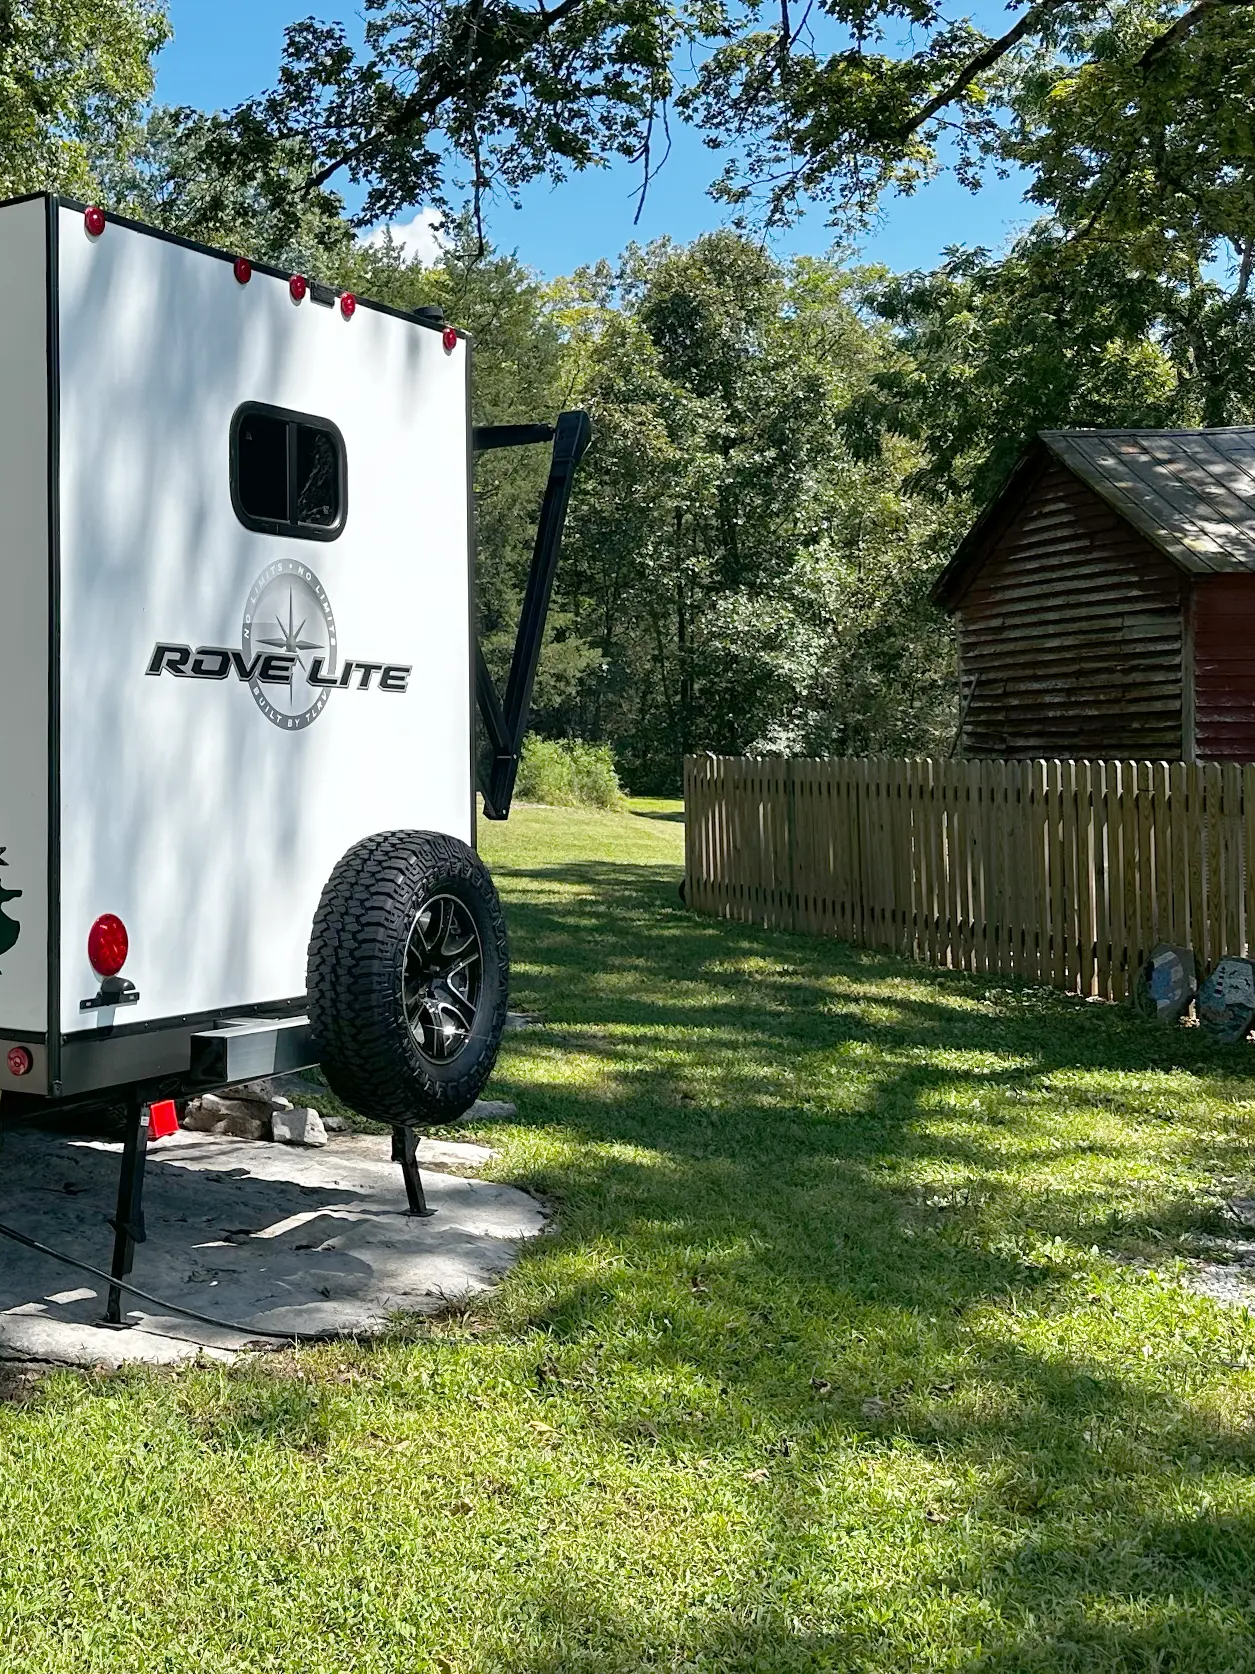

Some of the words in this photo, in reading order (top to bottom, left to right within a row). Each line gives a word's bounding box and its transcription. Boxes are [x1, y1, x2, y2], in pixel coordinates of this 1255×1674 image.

[243, 613, 251, 639] NO
[250, 562, 283, 605] LIMITS
[297, 566, 312, 581] NO
[145, 641, 300, 685] ROVE
[306, 655, 413, 693] LITE
[253, 686, 282, 723] BUILT
[287, 718, 301, 728] BY
[305, 690, 327, 722] TLRV
